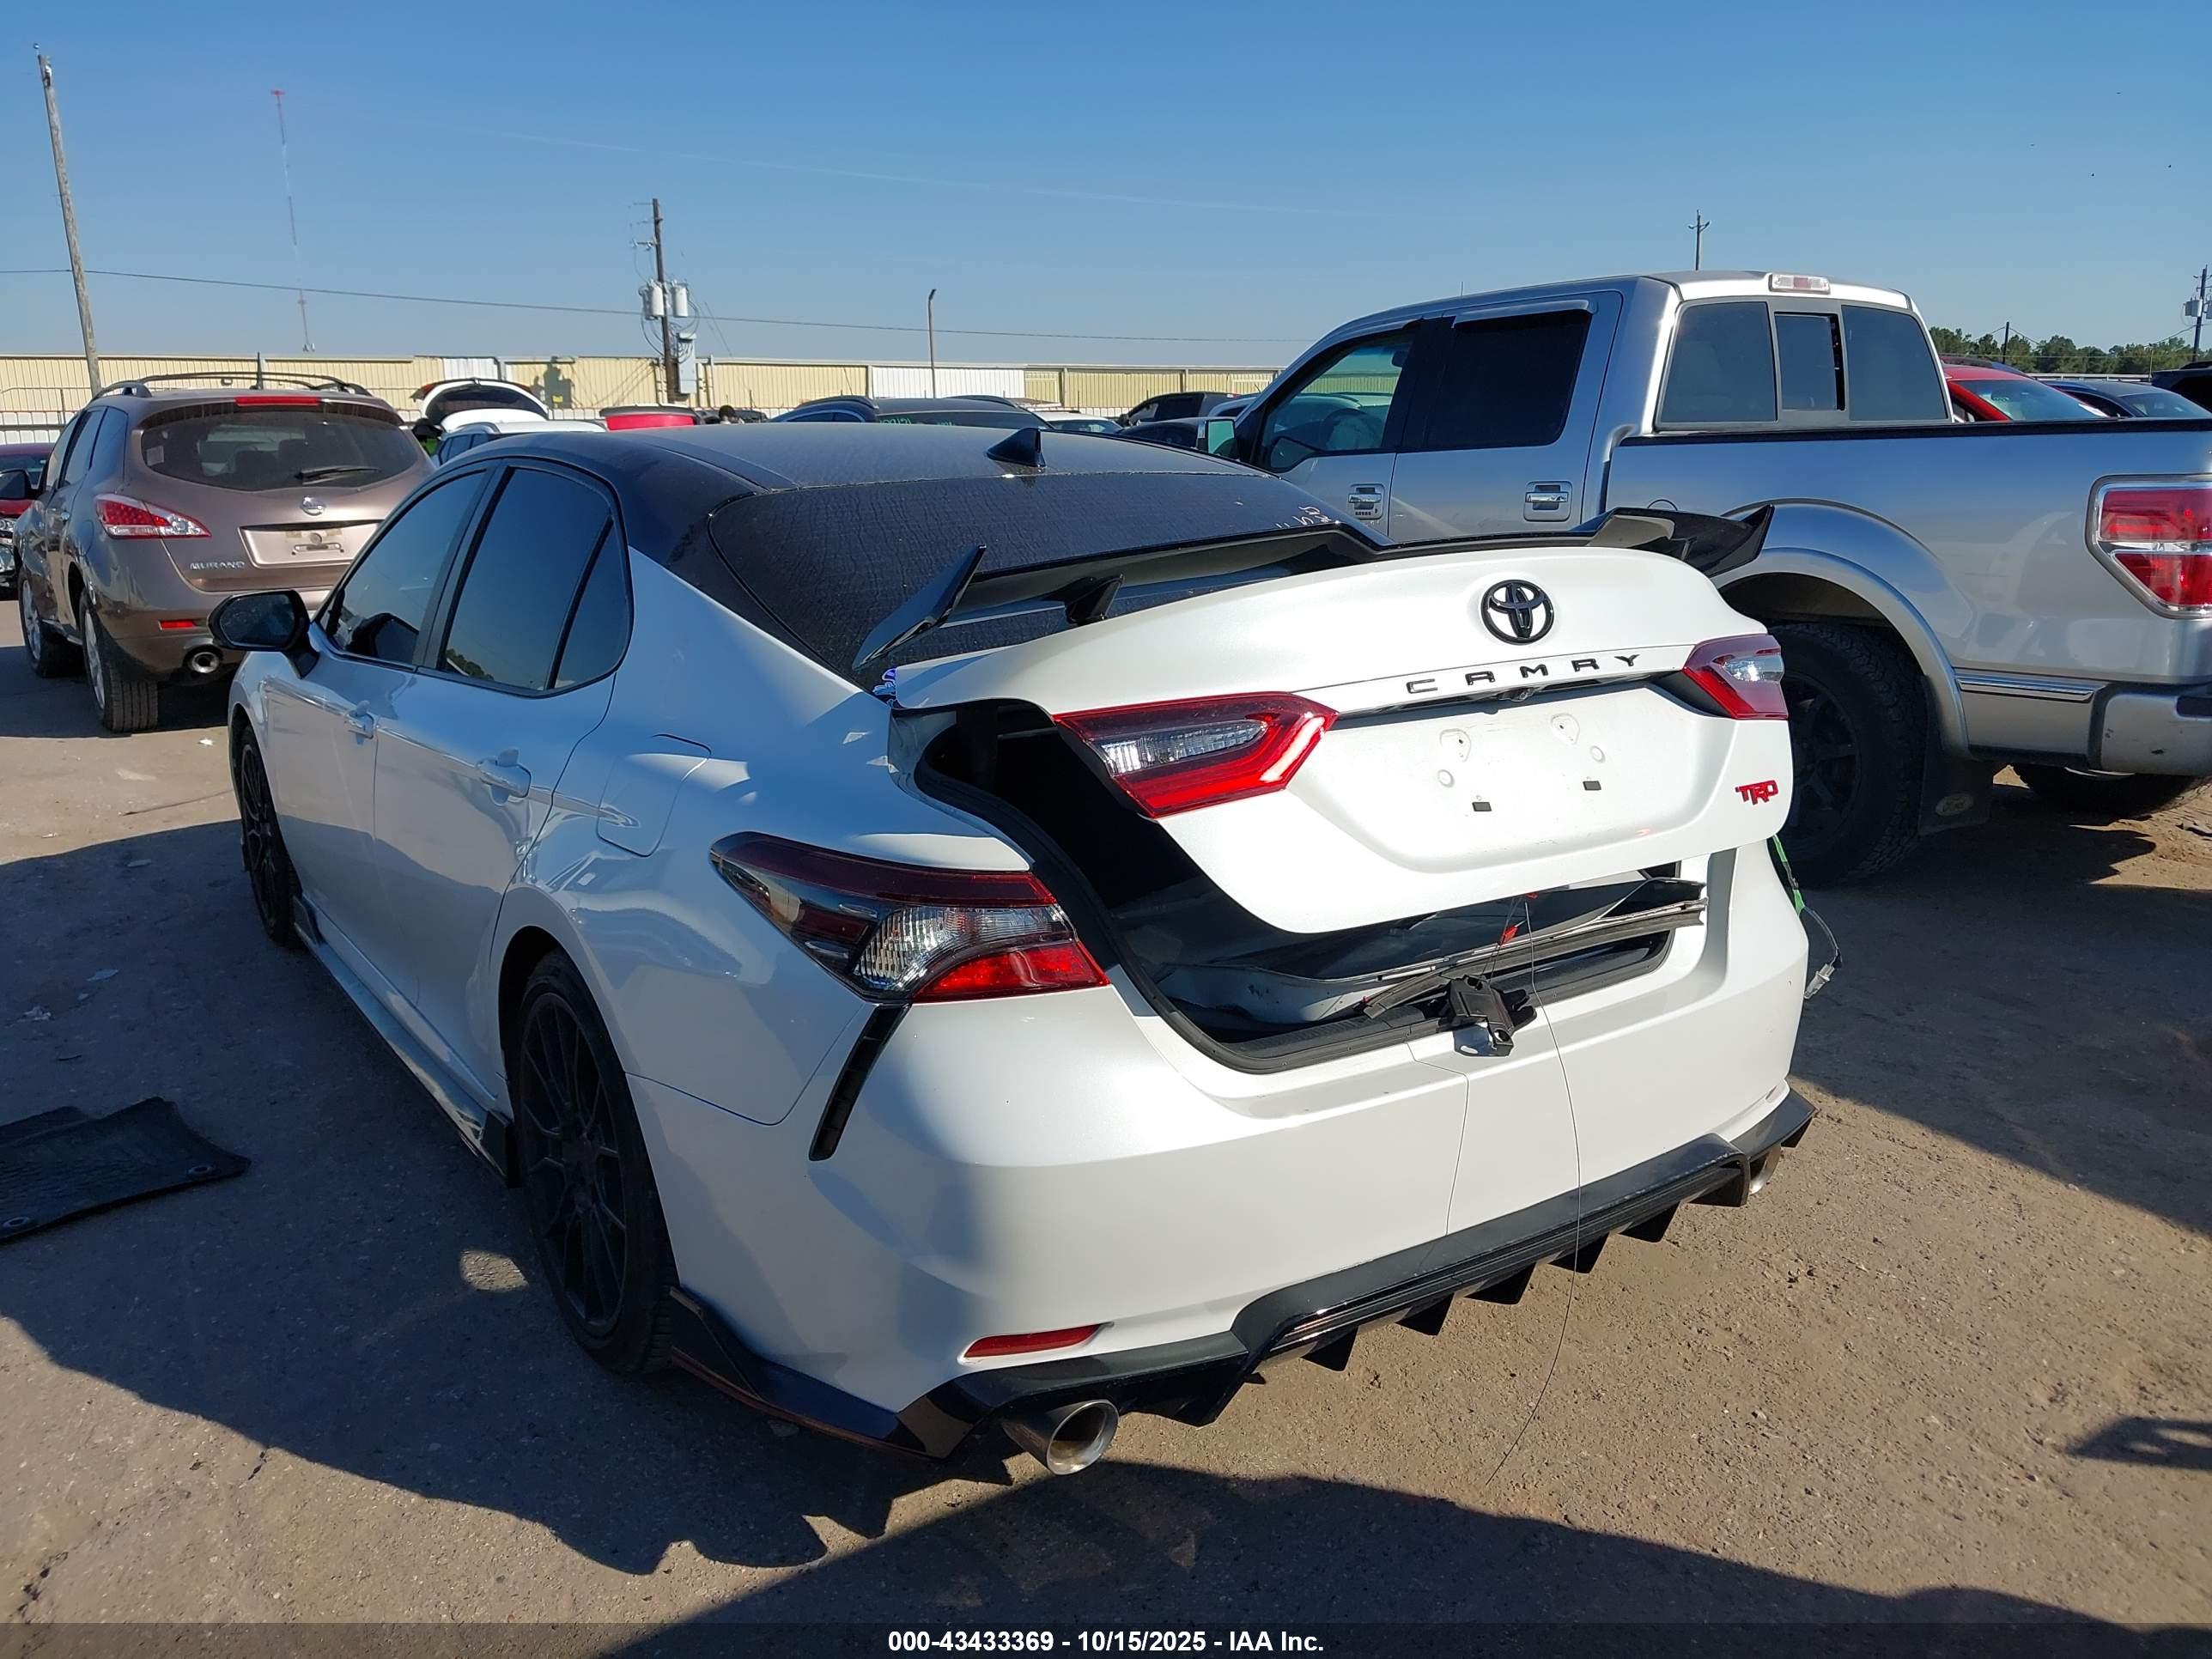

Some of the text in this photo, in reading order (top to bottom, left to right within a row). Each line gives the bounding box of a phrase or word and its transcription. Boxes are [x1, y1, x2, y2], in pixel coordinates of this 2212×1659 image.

[190, 561, 246, 570] MURANO
[1406, 653, 1641, 695] CAMRY
[1735, 780, 1778, 805] TRD
